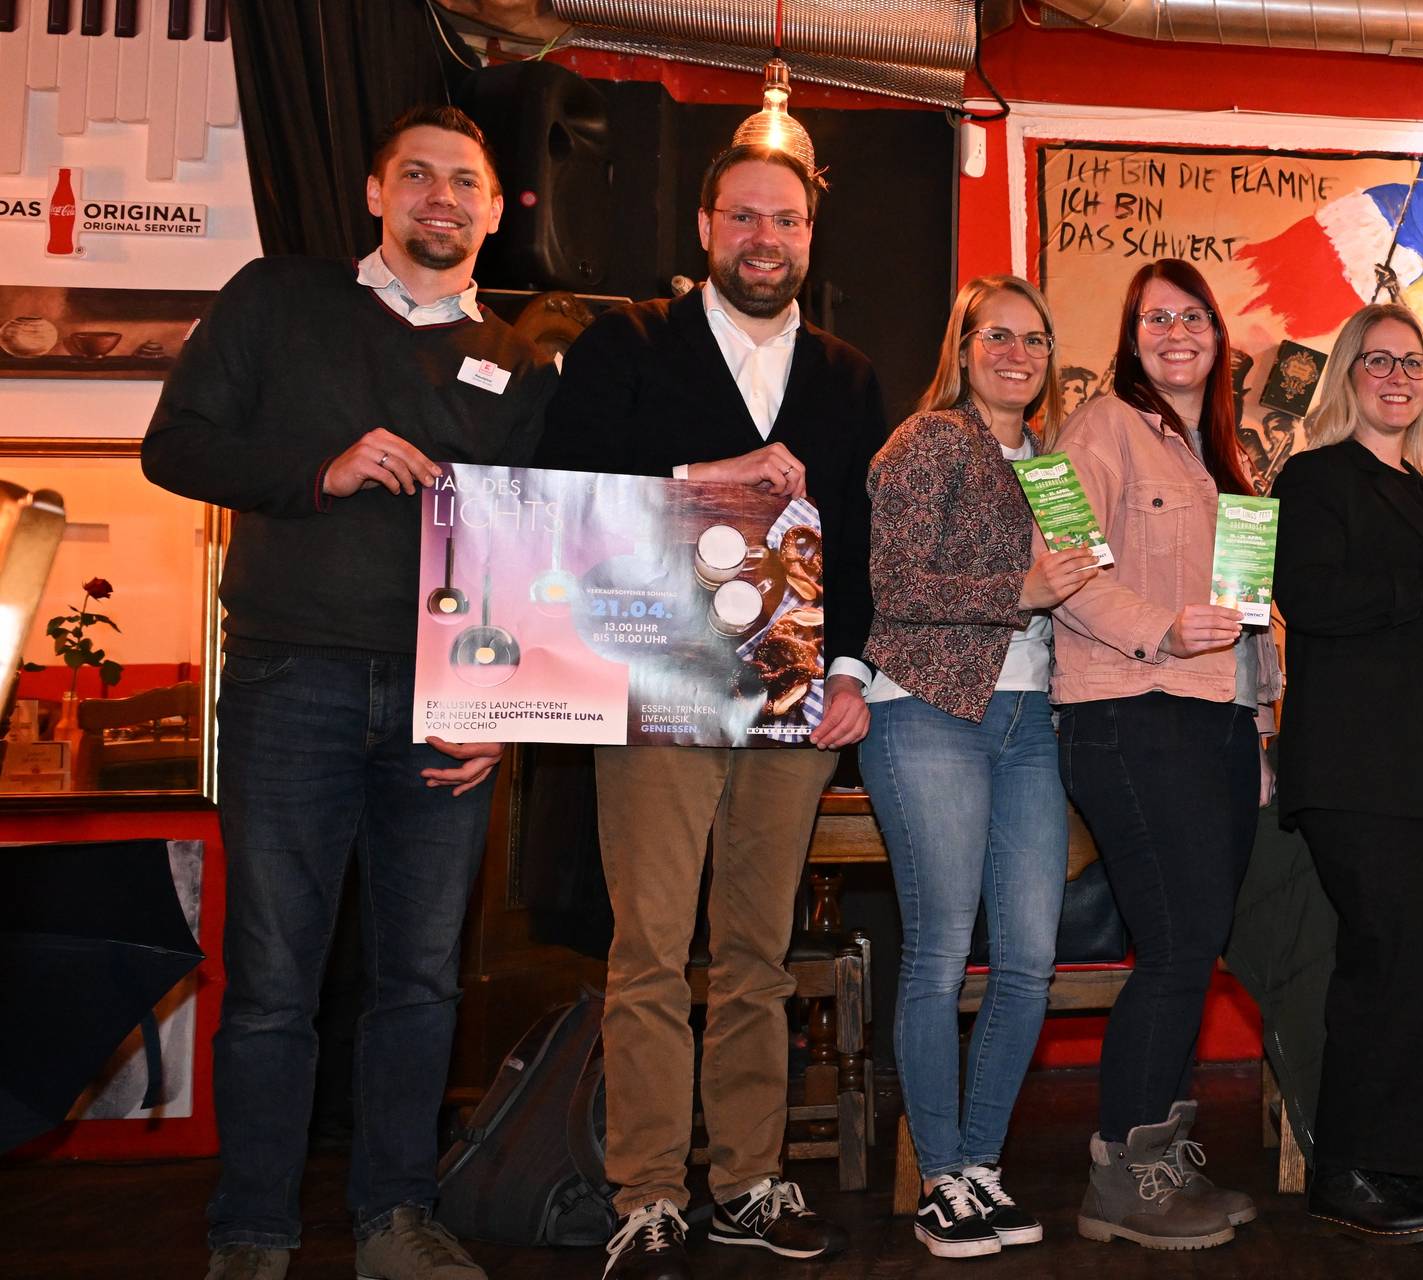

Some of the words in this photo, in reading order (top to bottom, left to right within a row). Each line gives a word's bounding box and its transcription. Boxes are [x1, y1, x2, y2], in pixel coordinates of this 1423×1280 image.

[1066, 153, 1111, 183] ICH
[1121, 157, 1166, 188] BIN
[1179, 162, 1222, 193] DIE
[1230, 165, 1340, 203] FLAMME
[83, 202, 201, 223] ORIGINAL
[1060, 186, 1101, 218] ICH
[1115, 192, 1163, 225] BIN
[82, 221, 141, 232] ORIGINAL
[144, 222, 200, 233] SERVIERT
[1057, 221, 1115, 253] DAS
[483, 478, 521, 496] DES
[433, 494, 564, 533] LICHTS
[591, 598, 673, 619] 21.04.
[604, 622, 633, 633] 13.00
[635, 624, 659, 633] UHR
[593, 632, 610, 642] BIS
[613, 633, 642, 644] 18.00
[644, 635, 668, 645] UHR
[489, 701, 568, 711] LAUNCH-EVENT
[676, 704, 718, 715] TRINKEN.
[449, 711, 486, 720] NEUEN
[488, 711, 572, 721] LEUCHTENSERIE
[574, 713, 604, 722] LUNA
[426, 721, 450, 730] VON
[453, 721, 498, 730] OCCHIO
